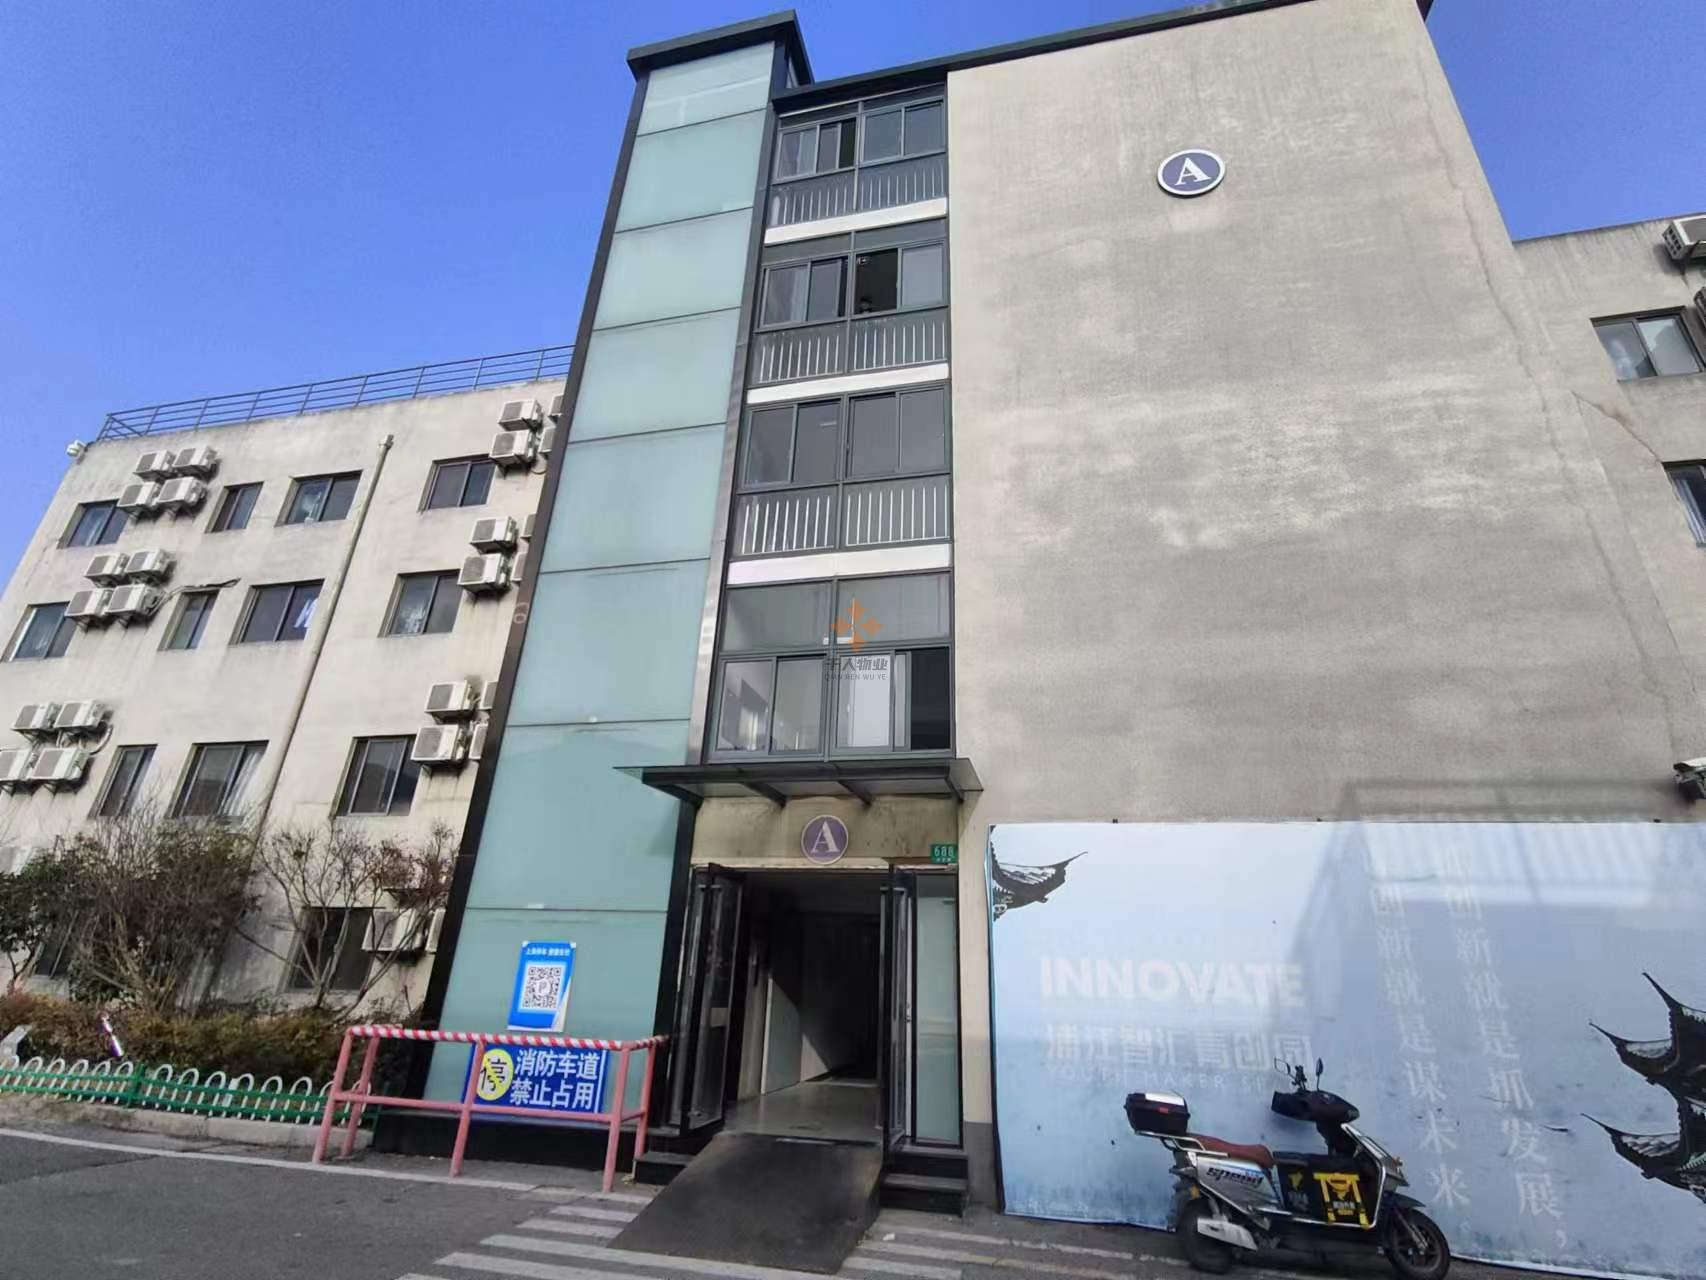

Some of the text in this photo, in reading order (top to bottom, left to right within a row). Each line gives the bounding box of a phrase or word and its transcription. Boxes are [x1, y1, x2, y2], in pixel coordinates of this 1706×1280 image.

[1174, 157, 1212, 186] A
[811, 821, 840, 853] A
[933, 846, 954, 857] 688
[1039, 955, 1306, 1008] INNOVATE
[480, 1058, 507, 1092] 停
[515, 1048, 600, 1081] 消防车道
[1145, 1070, 1226, 1090] MAKER
[510, 1077, 595, 1110] 禁止占用
